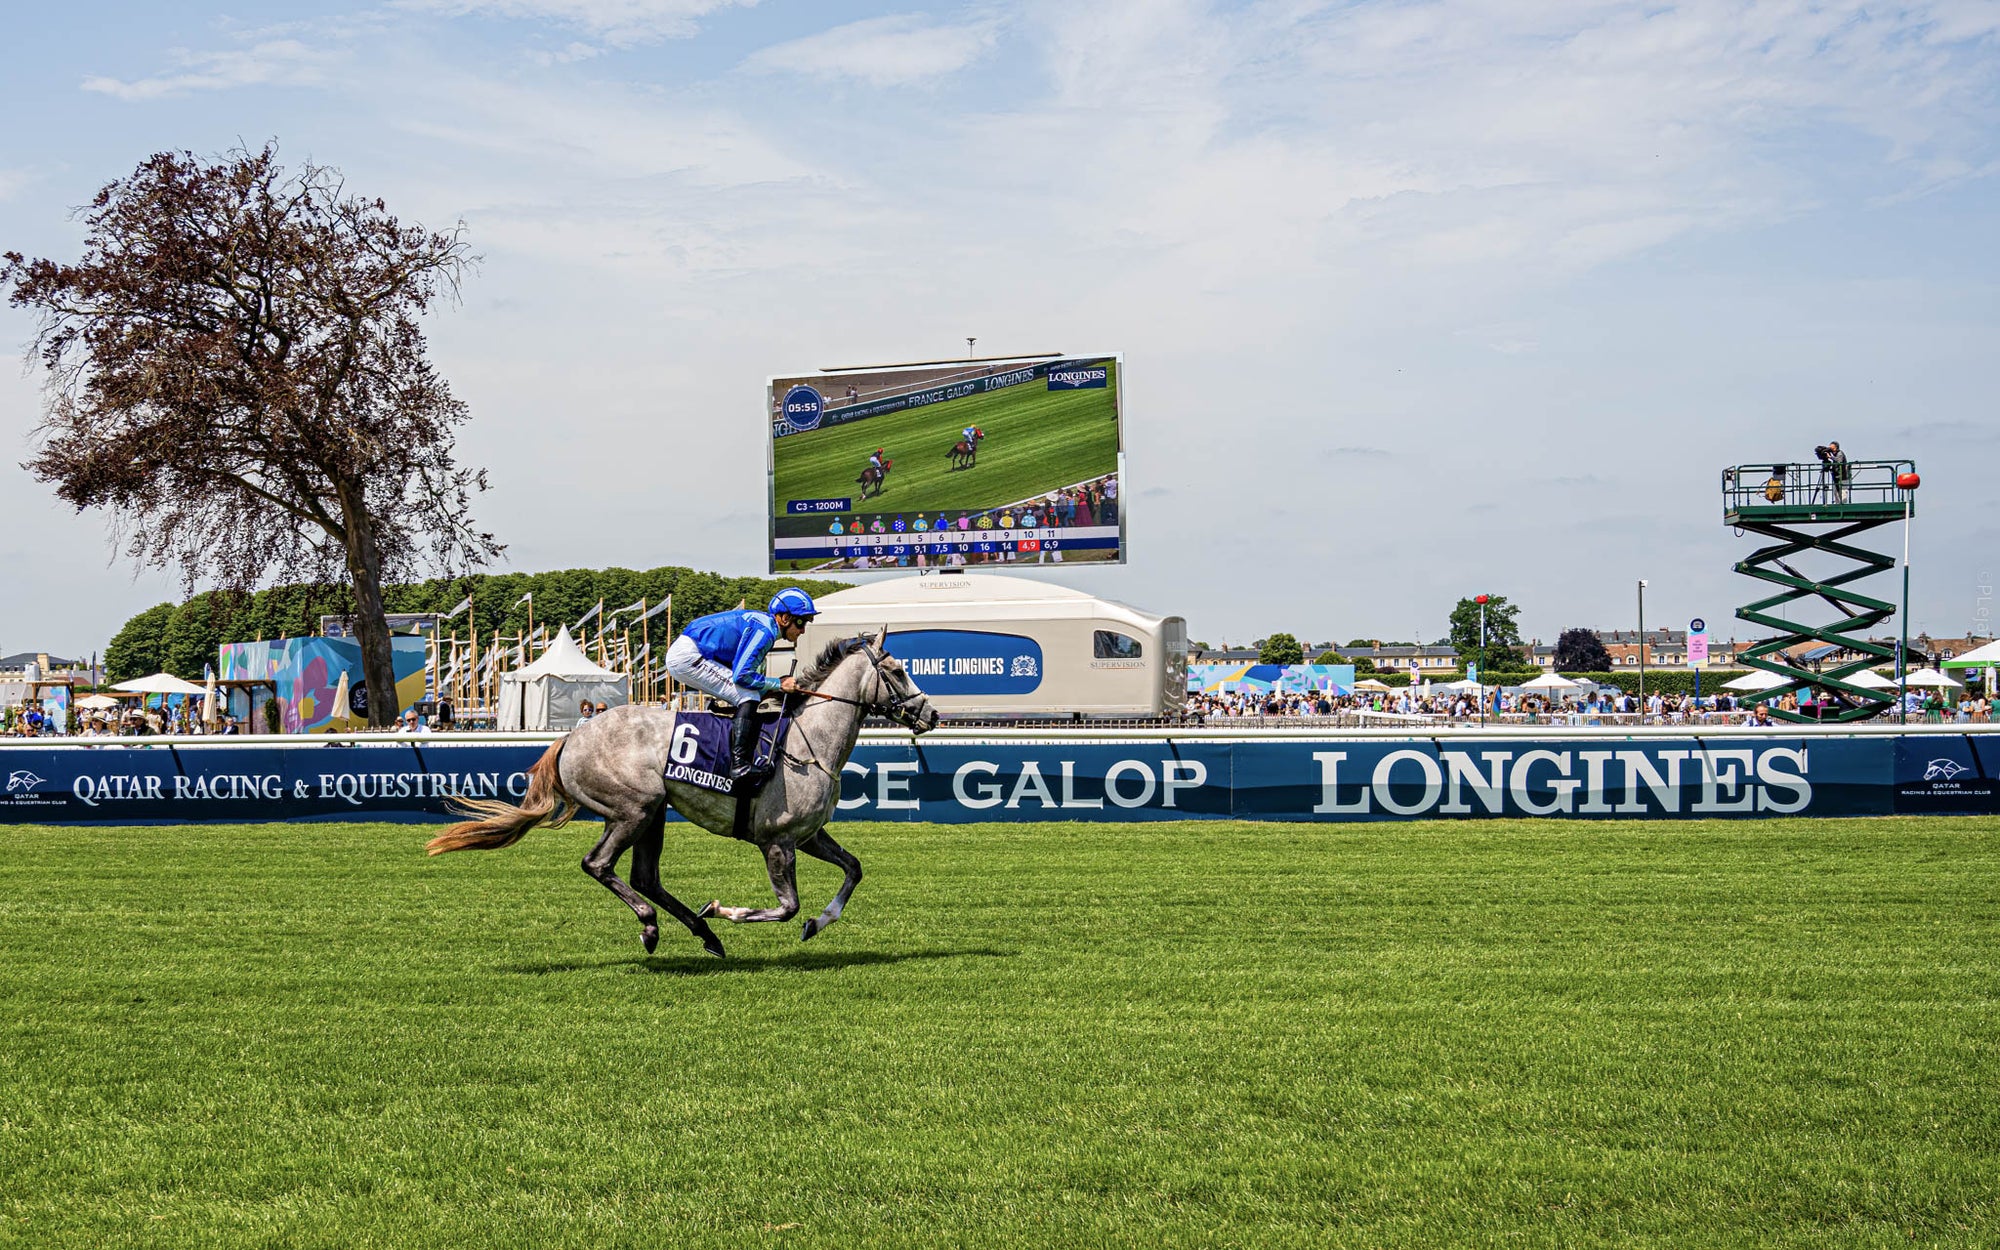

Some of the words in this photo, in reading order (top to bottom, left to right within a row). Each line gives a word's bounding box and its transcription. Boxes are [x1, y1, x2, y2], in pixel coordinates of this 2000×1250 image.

[984, 368, 1034, 392] LONGINES
[1049, 370, 1106, 382] LONGINES
[908, 389, 945, 407] FRANCE
[946, 383, 976, 400] GALOP
[788, 402, 818, 414] 05:55
[796, 502, 808, 511] C3
[816, 501, 844, 510] 1200M
[855, 537, 860, 545] 2
[875, 537, 881, 545] 3
[896, 535, 902, 543] 4
[917, 535, 923, 543] 5
[939, 534, 944, 542] 6
[960, 534, 966, 542] 7
[982, 532, 988, 540] 8
[1004, 532, 1009, 540] 9
[1024, 531, 1034, 539] 10
[1046, 530, 1055, 538] 11
[833, 548, 839, 556] 6
[853, 547, 861, 555] 11
[874, 546, 883, 554] 12
[894, 546, 904, 554] 29
[914, 545, 927, 554] 9,1
[935, 545, 948, 553] 7,5
[958, 544, 969, 552] 10
[980, 543, 990, 551] 16
[1002, 542, 1012, 550] 14
[1022, 541, 1036, 550] 4,9
[1044, 540, 1059, 549] 6,9
[919, 580, 971, 589] SUPERVISION
[912, 658, 946, 675] DIANE
[948, 658, 1004, 675] LONGINES
[1090, 661, 1146, 670] SUPERVISION
[671, 724, 700, 764] 6
[665, 763, 733, 793] LONGINES
[953, 760, 1208, 809] GALOP
[1313, 748, 1812, 815] LONGINES
[73, 775, 164, 806] QATAR
[174, 774, 282, 800] RACING
[294, 779, 309, 798] &
[319, 773, 499, 804] EQUESTRIAN
